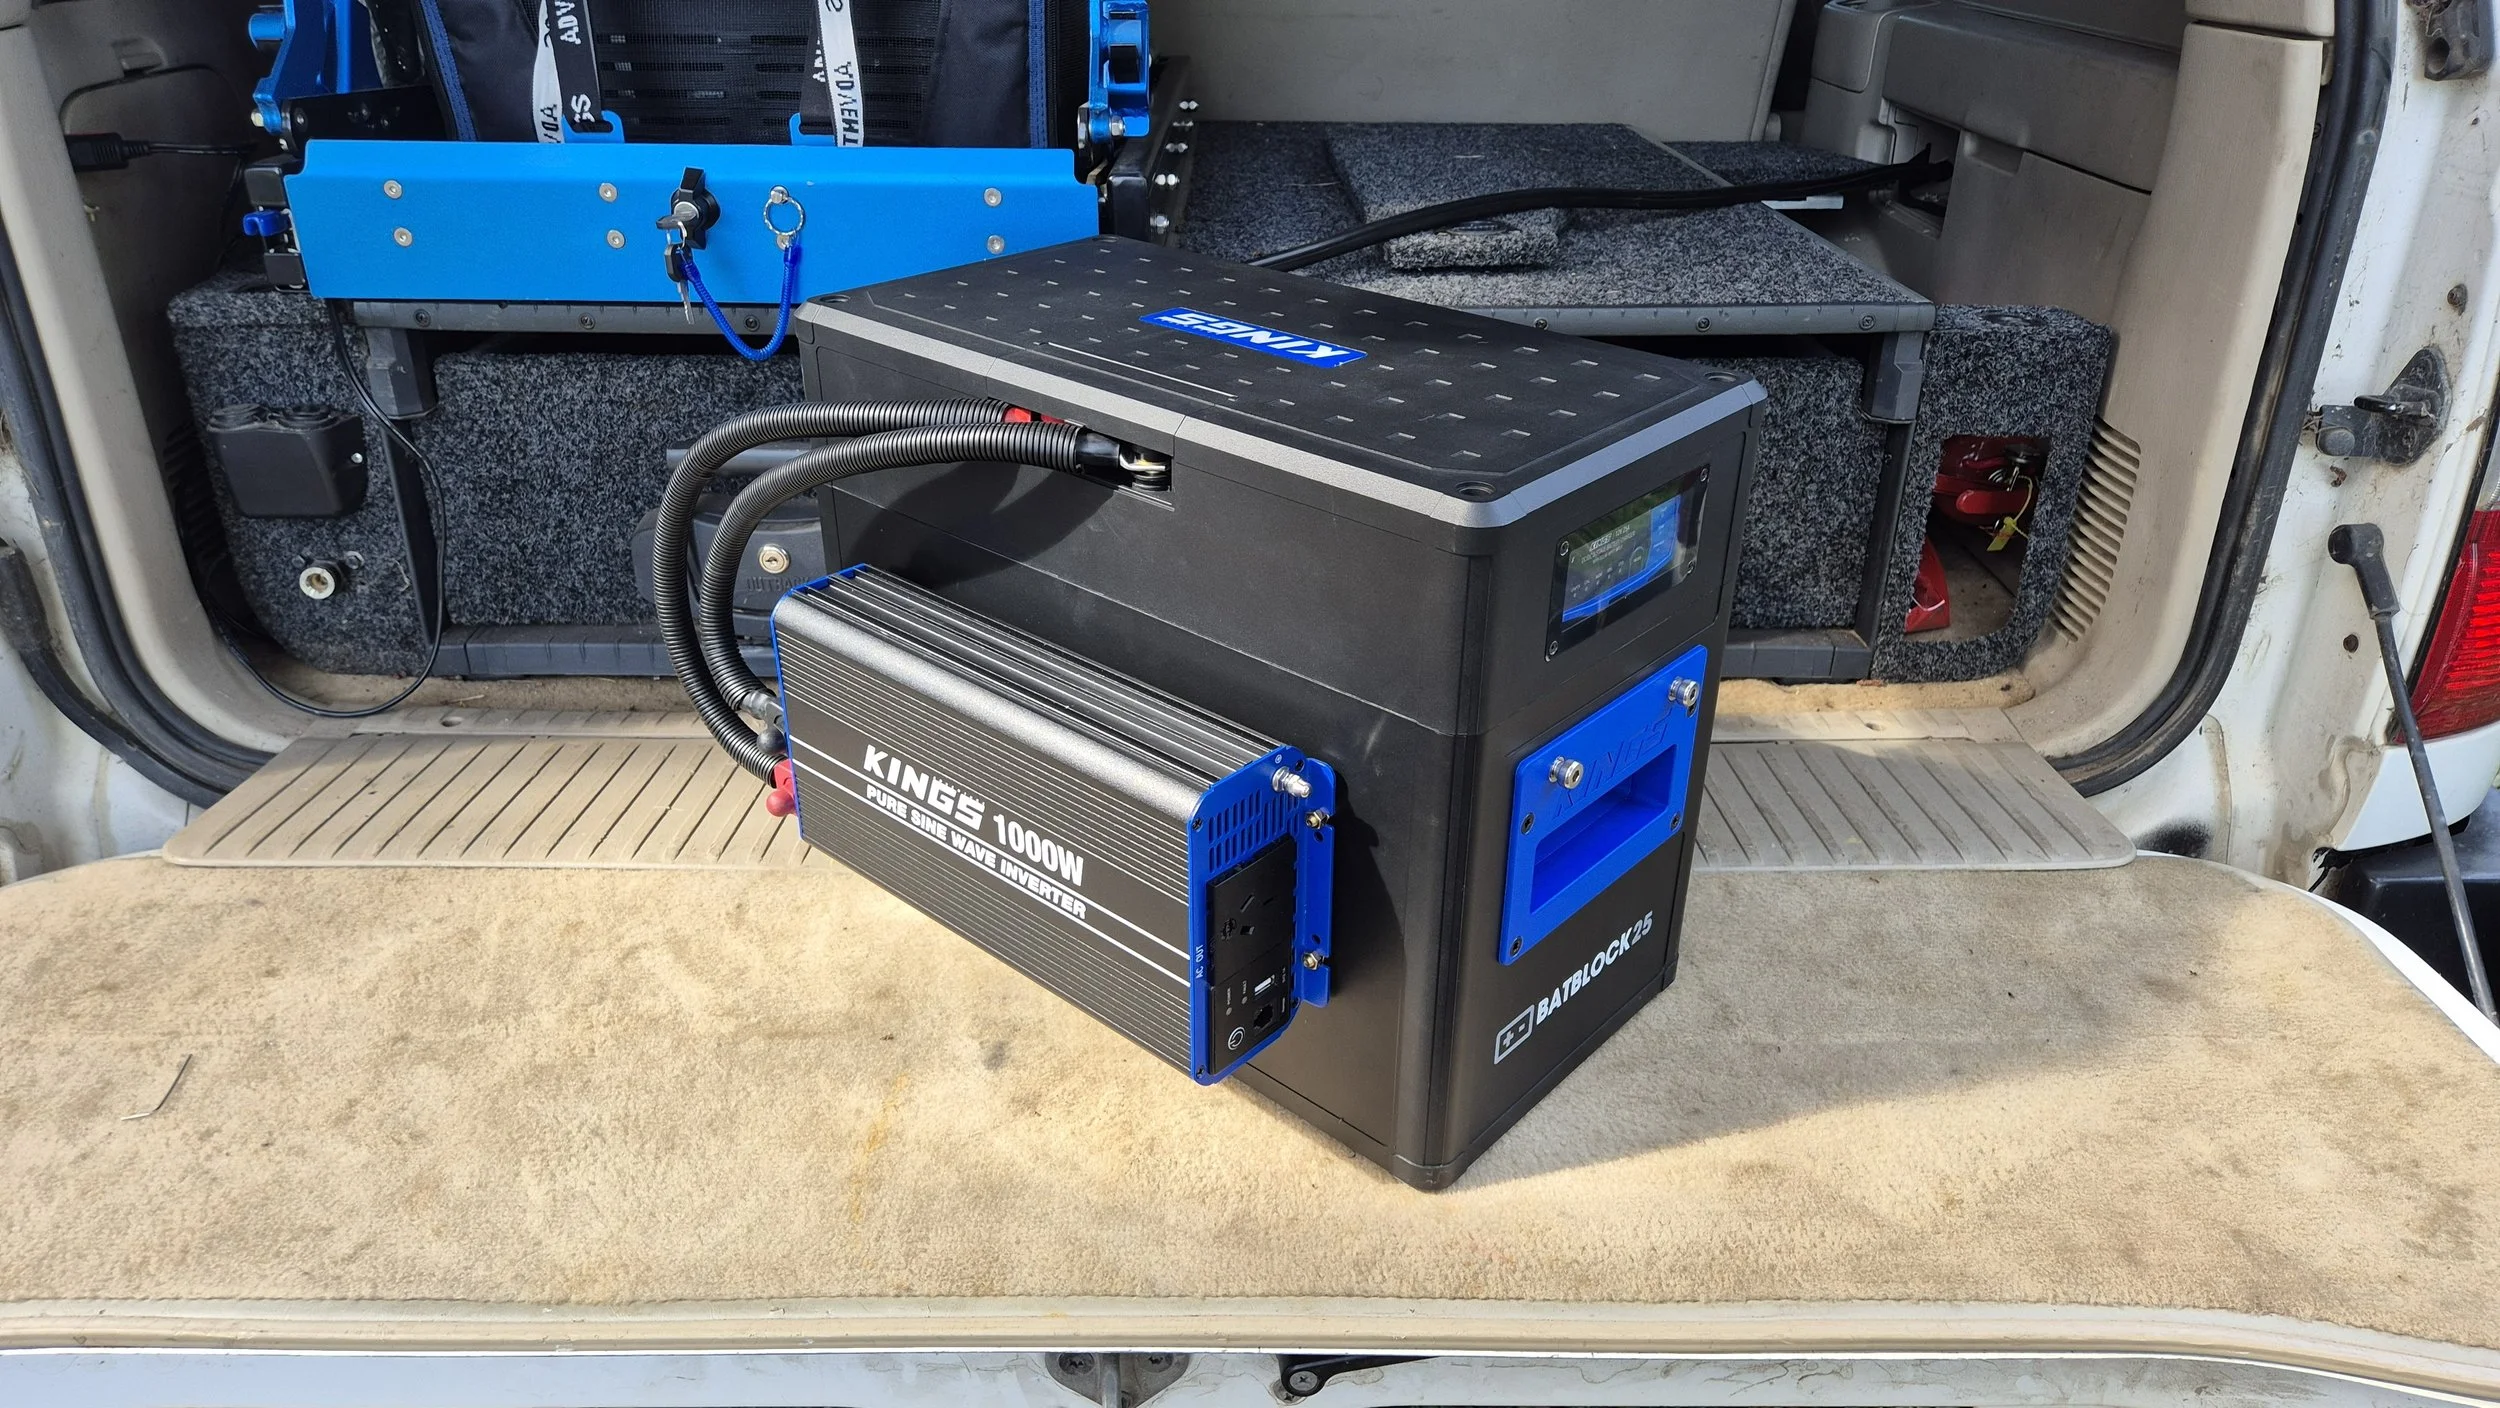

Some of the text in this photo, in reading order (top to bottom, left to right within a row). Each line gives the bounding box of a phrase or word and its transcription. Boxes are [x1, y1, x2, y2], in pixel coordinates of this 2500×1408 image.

[1156, 312, 1350, 359] KINGS
[863, 744, 1084, 887] KINGS 1000W
[866, 784, 1087, 920] PURE SINE WAVE INVERTER
[1195, 944, 1204, 979] AC OUT
